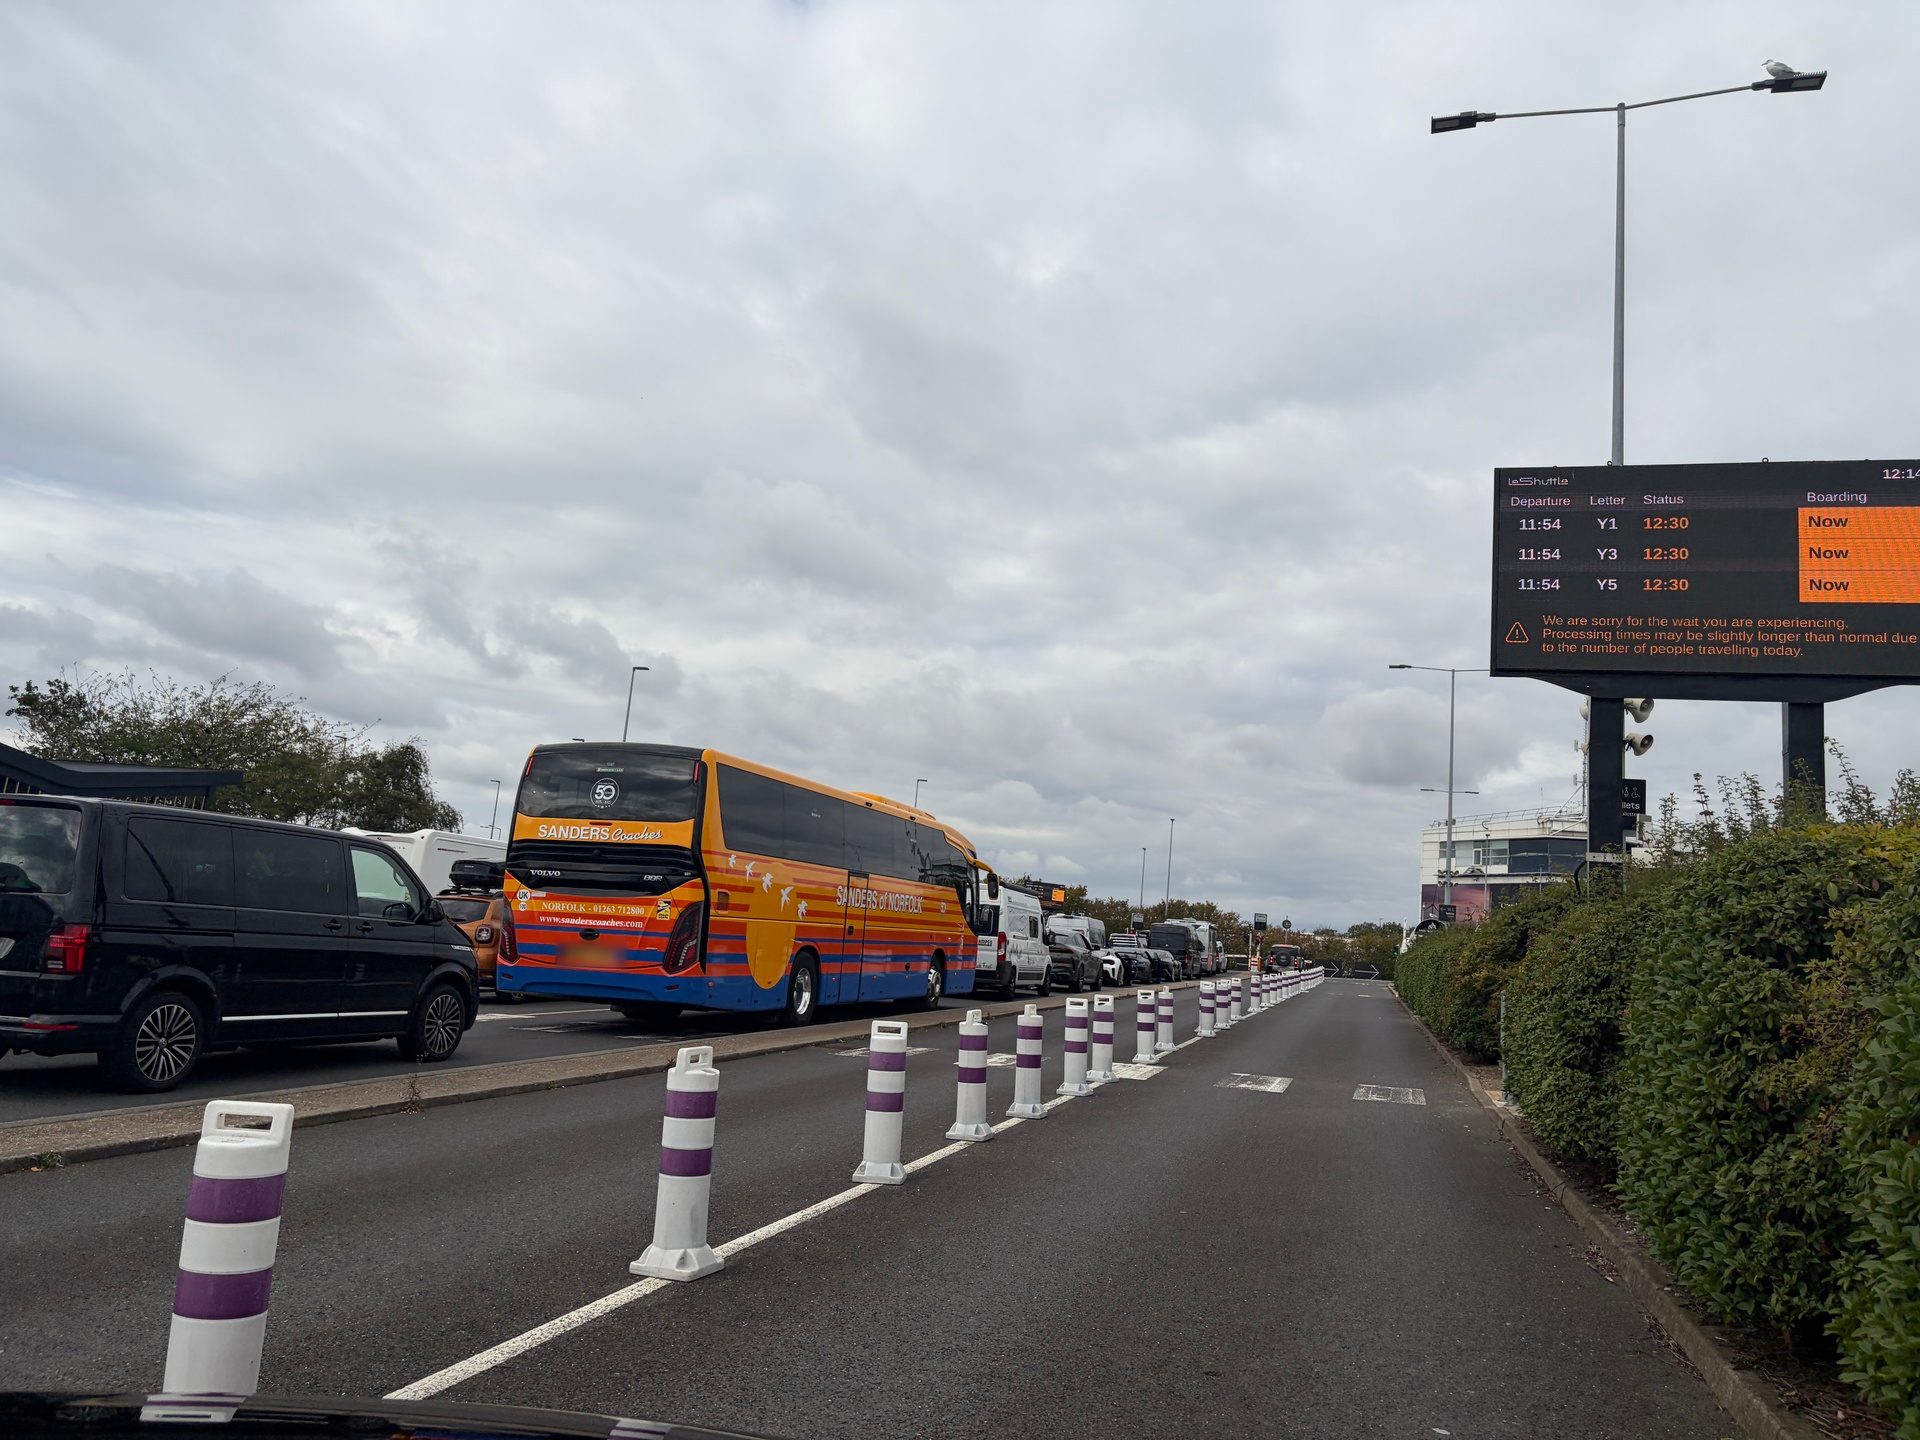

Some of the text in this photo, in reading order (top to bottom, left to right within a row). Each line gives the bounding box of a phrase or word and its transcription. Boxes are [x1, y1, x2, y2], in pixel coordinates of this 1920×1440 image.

[1510, 491, 1868, 508] Departure Letter Status Boarding
[1519, 515, 1849, 531] 11:54 Y1 12:30 Now
[1518, 546, 1849, 560] 11:54 Y3 12:30 Now
[1517, 578, 1850, 591] 11:54 Y5 12:30 Now
[1542, 615, 1849, 631] We are sorry for the wait you are experiencing.
[1542, 629, 1917, 644] Processing times may be slightly longer than normal due
[1542, 642, 1804, 658] to the number of people travelling today.
[538, 824, 663, 841] SANDERS Coaches
[530, 869, 561, 877] VOLVO
[518, 891, 529, 900] UK
[836, 885, 878, 910] SANDERS
[879, 893, 888, 911] of
[889, 893, 923, 915] NORFOLK
[542, 902, 586, 912] NORFOLK
[593, 905, 615, 914] 01263
[618, 906, 645, 915] 712800
[539, 915, 644, 929] www.sanderscoaches.com
